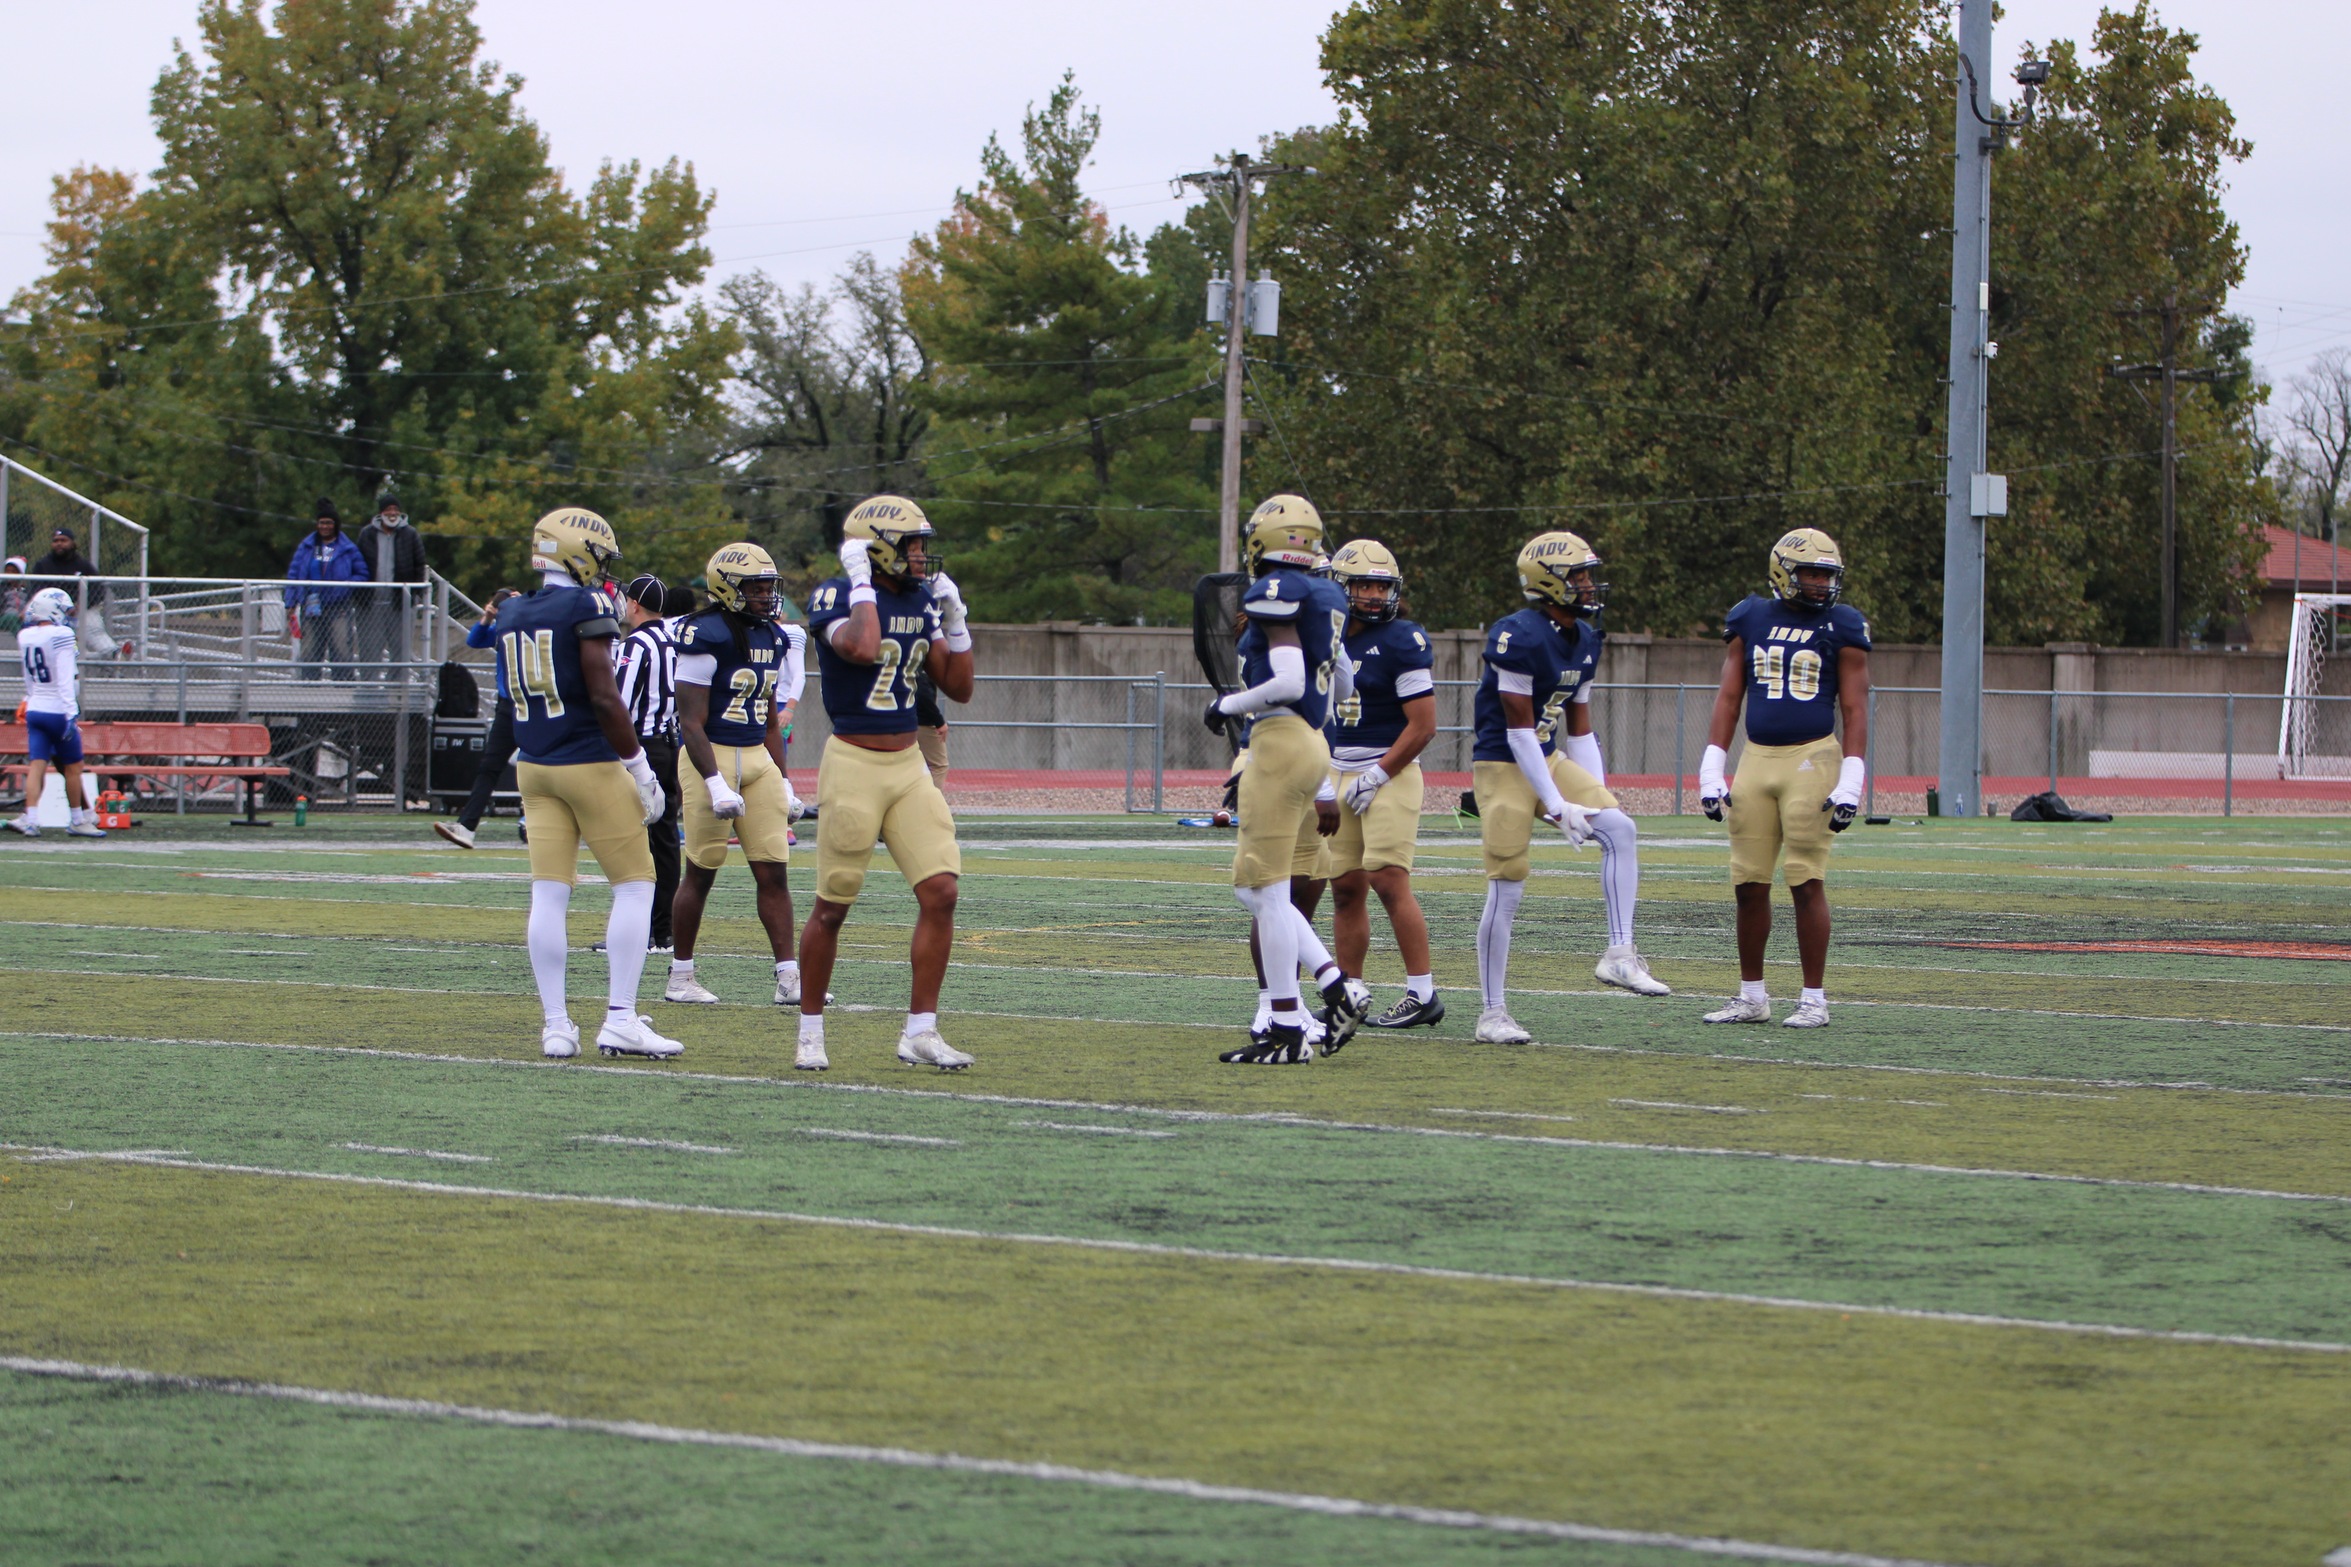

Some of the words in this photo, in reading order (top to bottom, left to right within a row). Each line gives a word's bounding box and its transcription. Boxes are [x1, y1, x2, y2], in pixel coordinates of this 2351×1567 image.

[858, 505, 902, 521] INDY
[569, 515, 609, 537] INDY
[1530, 542, 1568, 560] INDY
[590, 592, 616, 615] 14
[812, 587, 838, 612] 29
[888, 616, 925, 634] INDY
[1767, 626, 1815, 644] INDY
[1496, 631, 1513, 655] 5
[502, 629, 566, 722] 14
[1753, 644, 1823, 702] 40
[721, 668, 779, 726] 25
